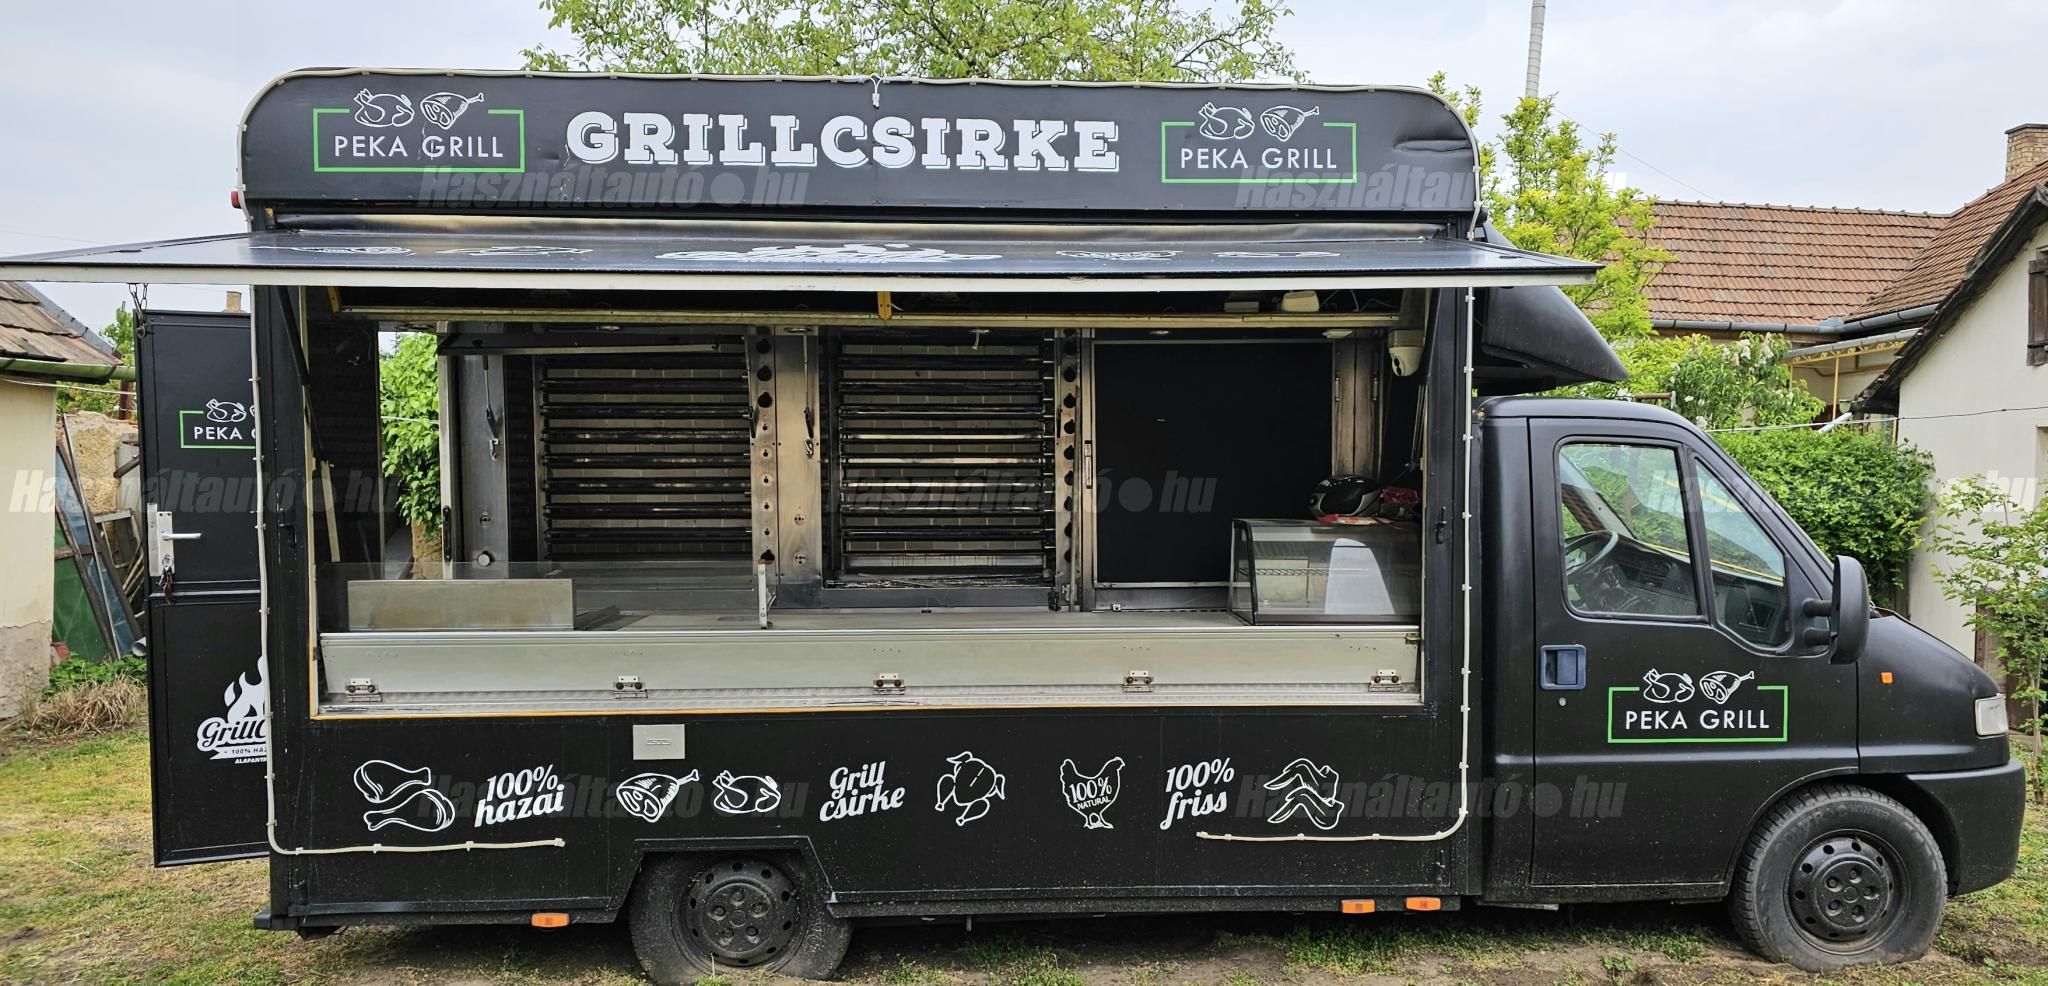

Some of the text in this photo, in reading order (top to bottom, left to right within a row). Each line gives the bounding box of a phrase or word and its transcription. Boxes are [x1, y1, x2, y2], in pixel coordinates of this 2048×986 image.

[334, 135, 504, 159] PEKA GRILL
[565, 111, 1120, 173] GRILLCSIRKE
[1180, 147, 1337, 170] PEKA GRILL
[194, 426, 243, 440] PEKA
[201, 719, 266, 748] GrillC
[1625, 707, 1770, 730] PEKA GRILL
[486, 764, 559, 802] 100%
[829, 760, 886, 800] Grill
[1069, 776, 1113, 804] 100%
[1165, 757, 1235, 793] 100%
[474, 784, 565, 828] hazai
[819, 784, 906, 822] csirke
[1077, 796, 1111, 810] NATURAL
[1159, 789, 1227, 831] friss
